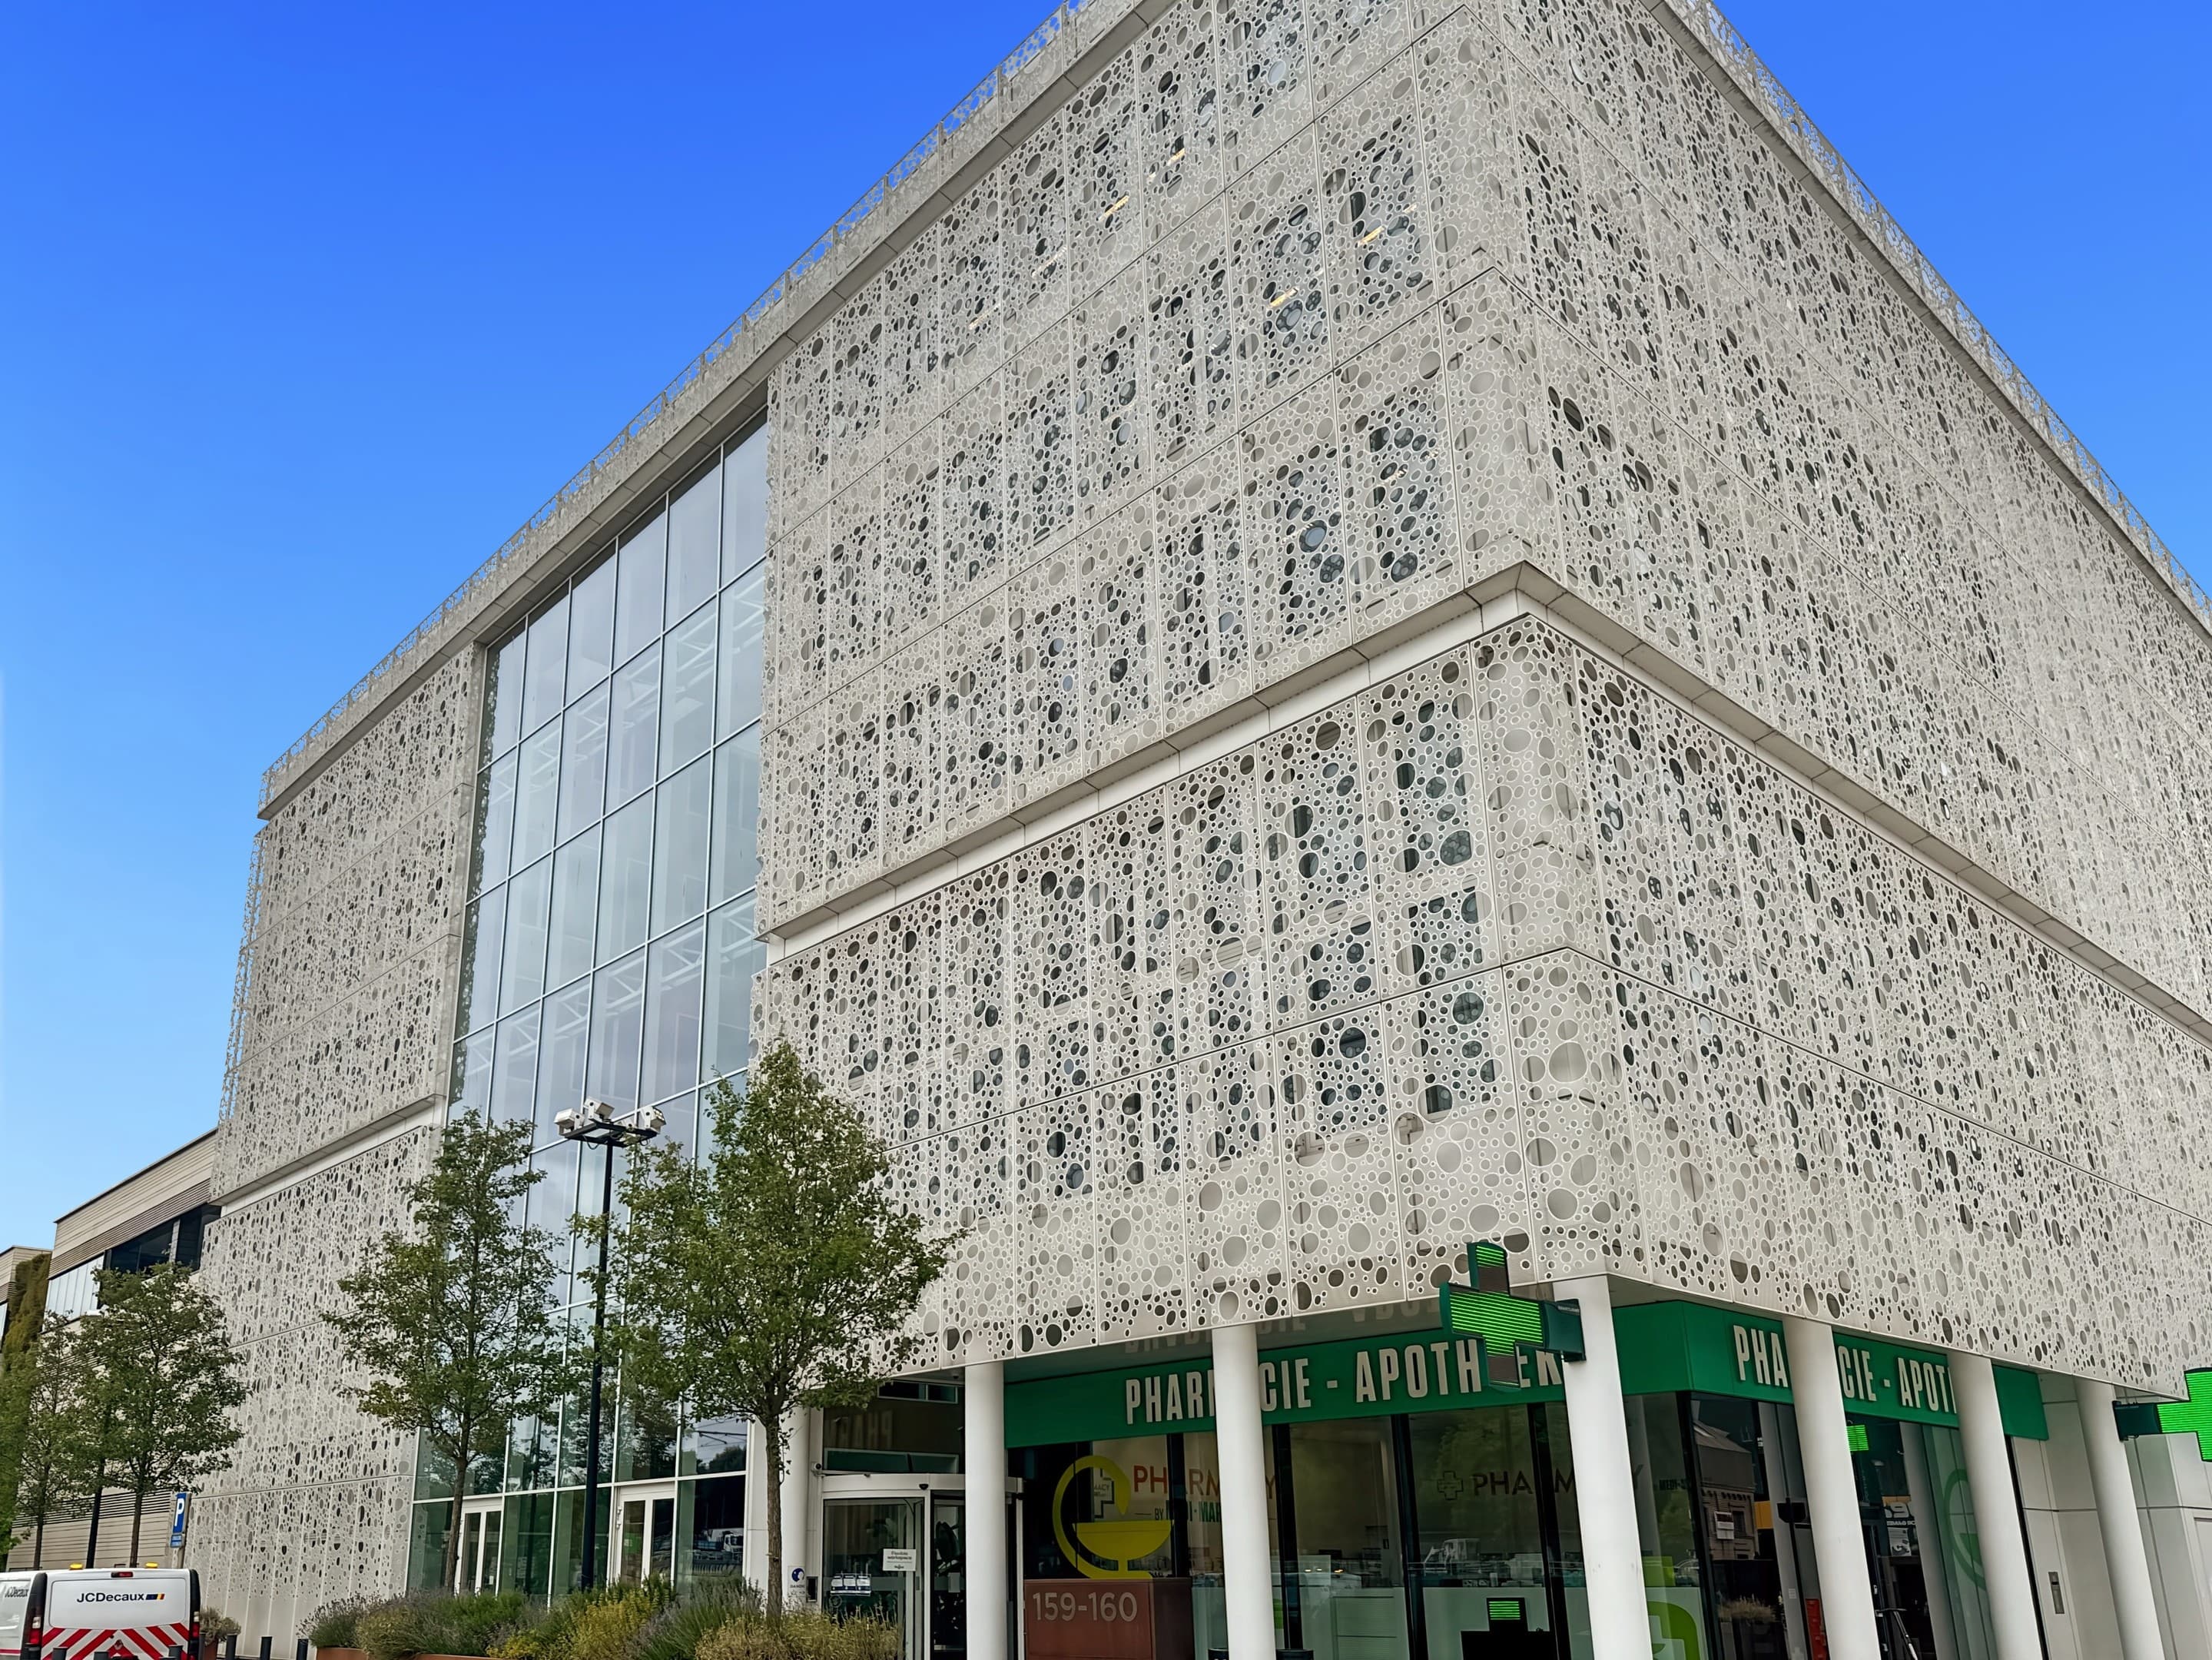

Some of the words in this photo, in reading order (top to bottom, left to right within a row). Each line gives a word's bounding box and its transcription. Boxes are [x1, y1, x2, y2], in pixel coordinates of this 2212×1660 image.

[1733, 1324, 1877, 1402] PHACIE
[1882, 1378, 1892, 1388] -
[1897, 1356, 1957, 1414] APOT
[1125, 1357, 1312, 1425] PHARCIE
[1326, 1379, 1338, 1389] -
[174, 1498, 185, 1527] P
[76, 1592, 145, 1603] JCDecaux
[1032, 1592, 1138, 1622] 159-160
